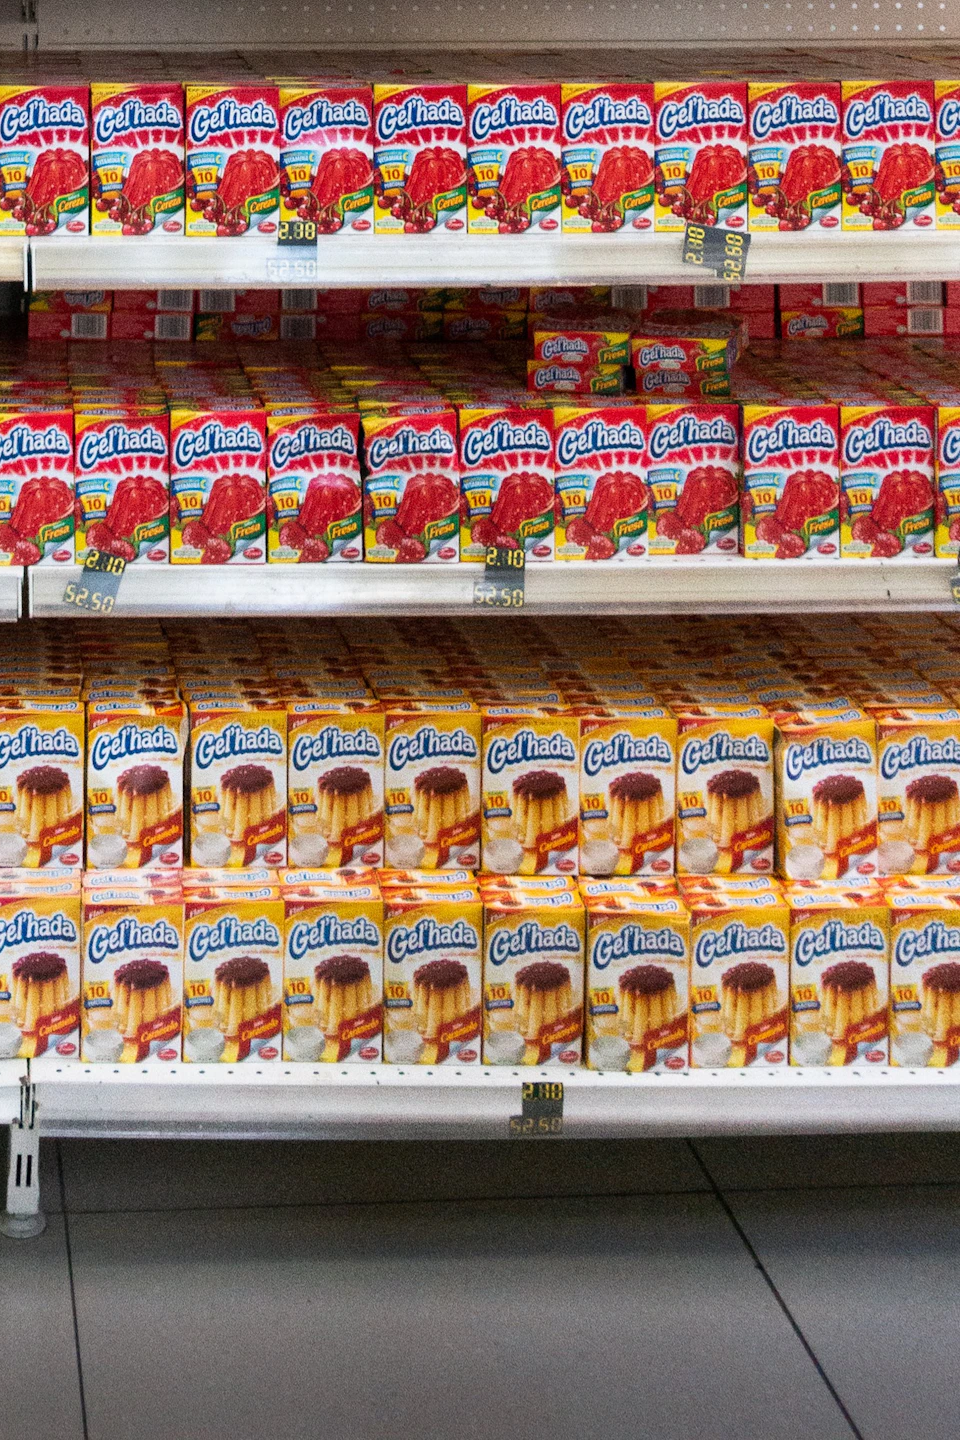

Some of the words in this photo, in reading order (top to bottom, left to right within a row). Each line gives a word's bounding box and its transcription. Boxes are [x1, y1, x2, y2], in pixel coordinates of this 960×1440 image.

[192, 101, 275, 142] Gel'hada
[473, 98, 556, 139] Gel'hada
[754, 96, 837, 137] Gel'hada
[249, 197, 276, 213] Cereza
[811, 192, 838, 208] Cereza
[603, 349, 625, 363] Fresa
[701, 356, 724, 369] Fresa
[178, 425, 261, 466] Gel'hada
[561, 423, 644, 464] Gel'hada
[848, 421, 931, 462] Gel'hada
[181, 497, 197, 508] 10
[235, 523, 260, 538] Fresa
[618, 520, 643, 535] Fresa
[86, 550, 125, 575] 2.10
[487, 547, 524, 568] 2.10
[63, 584, 114, 613] 52.50
[473, 586, 524, 608] 52.50
[92, 724, 176, 765] Gel'hada
[389, 726, 476, 769] Gel'hada
[190, 917, 280, 963] Gel'hada
[697, 923, 784, 967] Gel'hada
